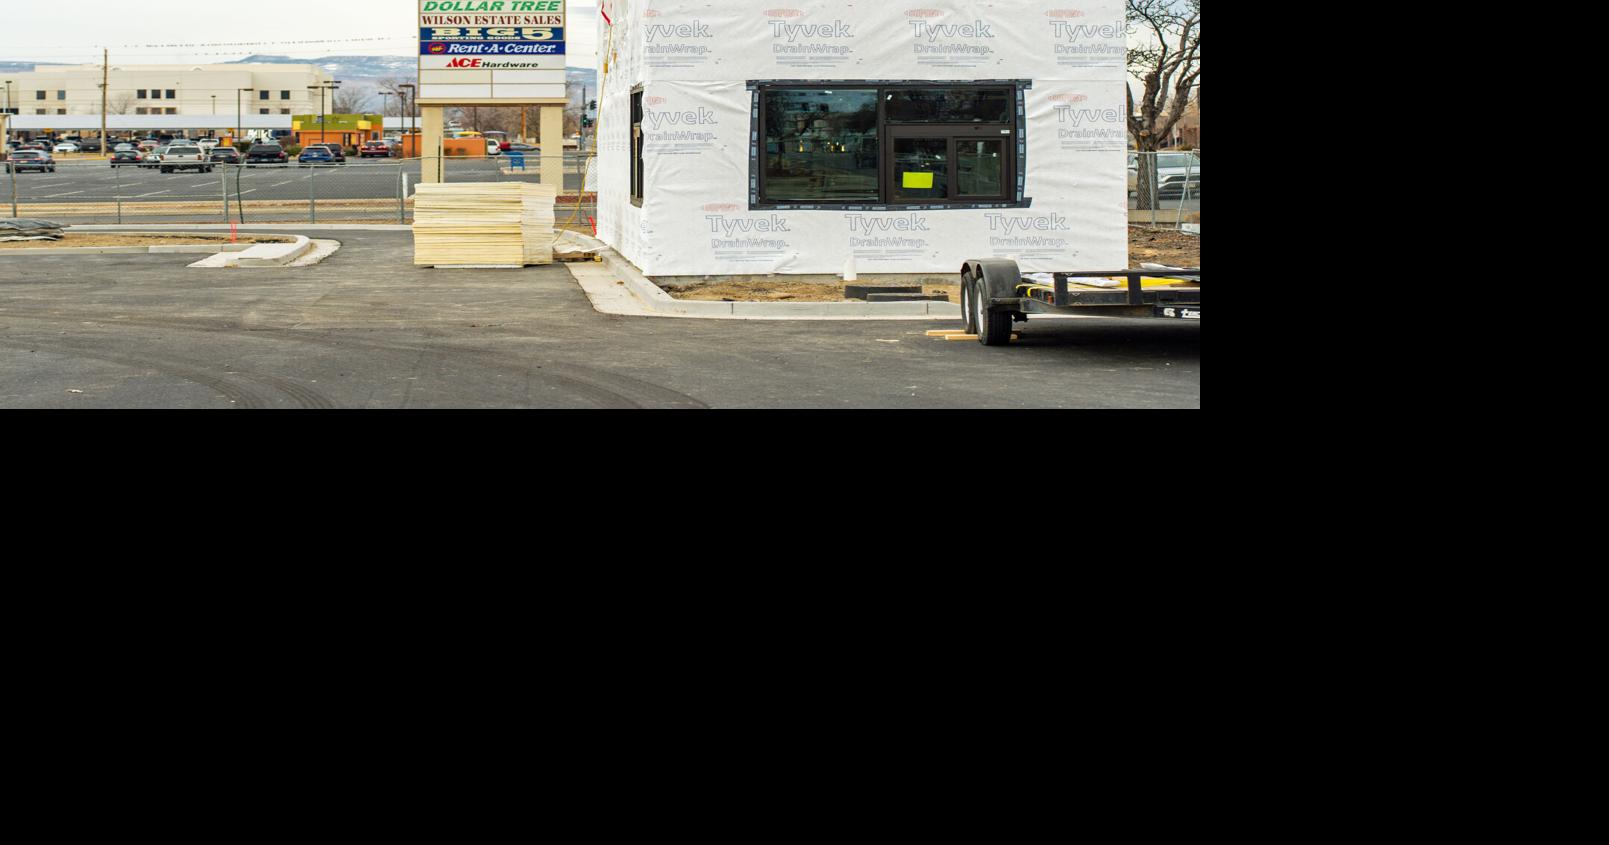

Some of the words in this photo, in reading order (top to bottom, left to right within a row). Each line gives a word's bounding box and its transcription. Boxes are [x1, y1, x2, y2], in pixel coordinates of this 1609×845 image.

[424, 1, 505, 12] DOLLAR
[511, 1, 560, 11] TREE
[422, 16, 471, 25] WILSON
[474, 16, 521, 25] ESTATE
[524, 16, 561, 25] SALES
[431, 28, 519, 36] BIG
[521, 28, 554, 40] 5
[644, 20, 713, 42] yvek
[645, 43, 713, 55] rainWrap
[446, 57, 482, 68] ACE
[646, 106, 718, 130] yvek
[648, 130, 717, 142] rainWrap
